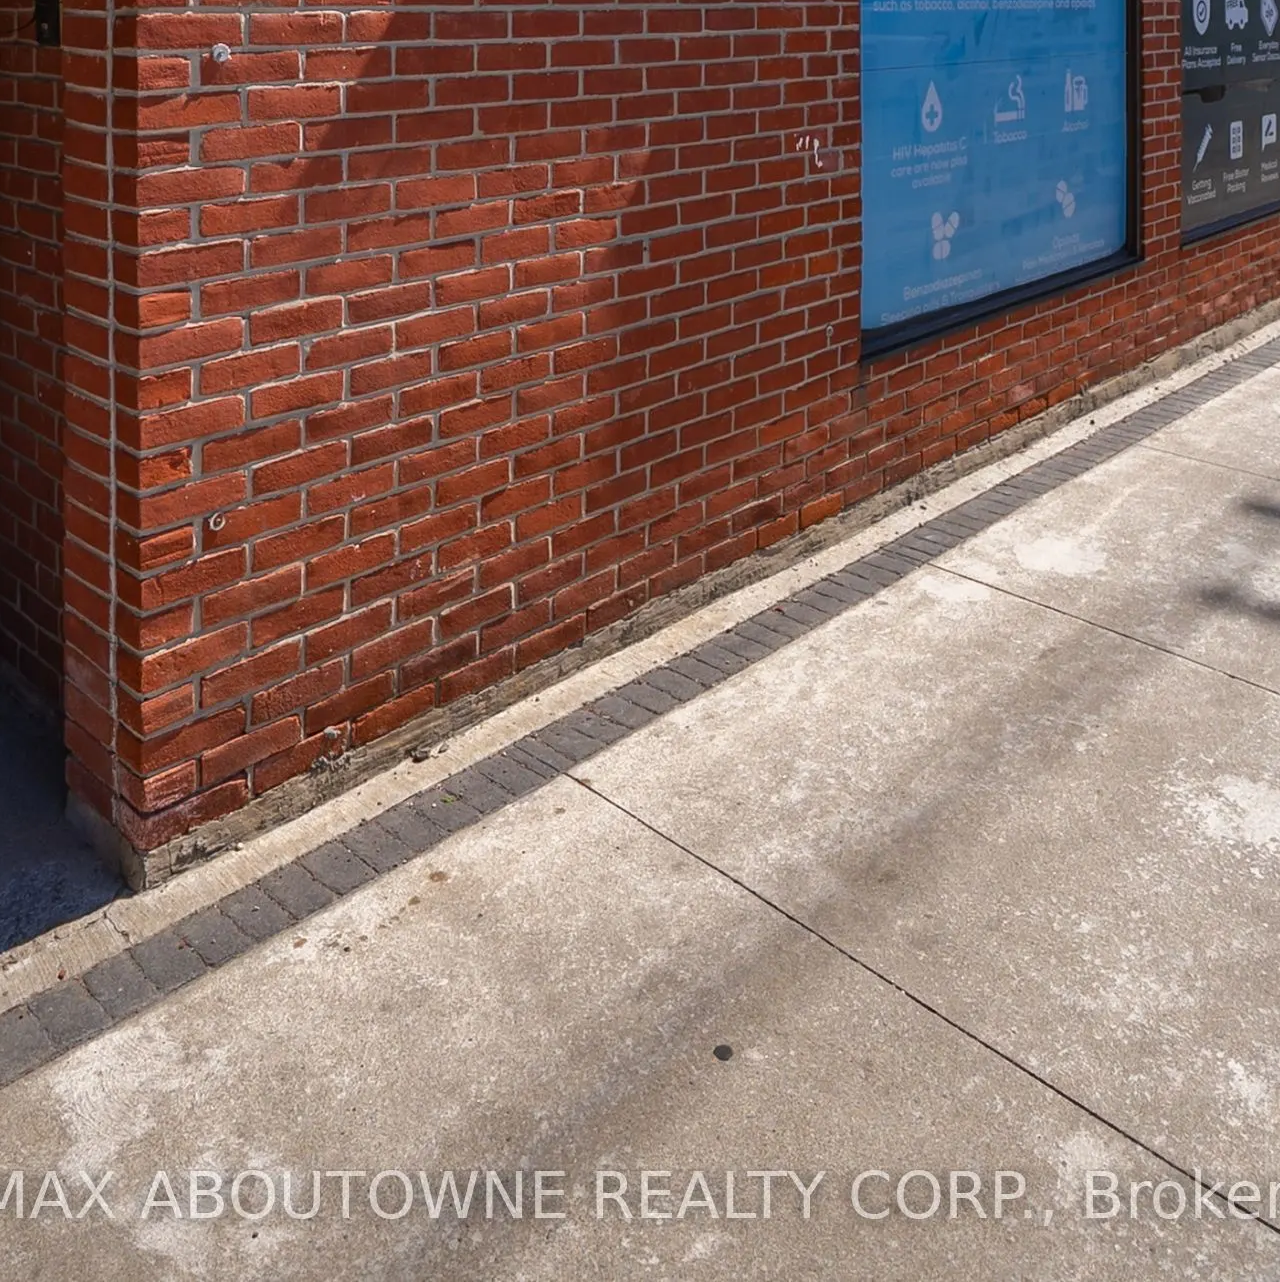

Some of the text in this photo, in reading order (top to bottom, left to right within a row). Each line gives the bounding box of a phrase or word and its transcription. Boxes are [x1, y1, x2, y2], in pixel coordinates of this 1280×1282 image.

[899, 0, 913, 12] as
[993, 129, 1029, 145] Tobacco
[892, 144, 913, 161] HIV
[958, 136, 968, 151] C
[890, 165, 912, 178] care
